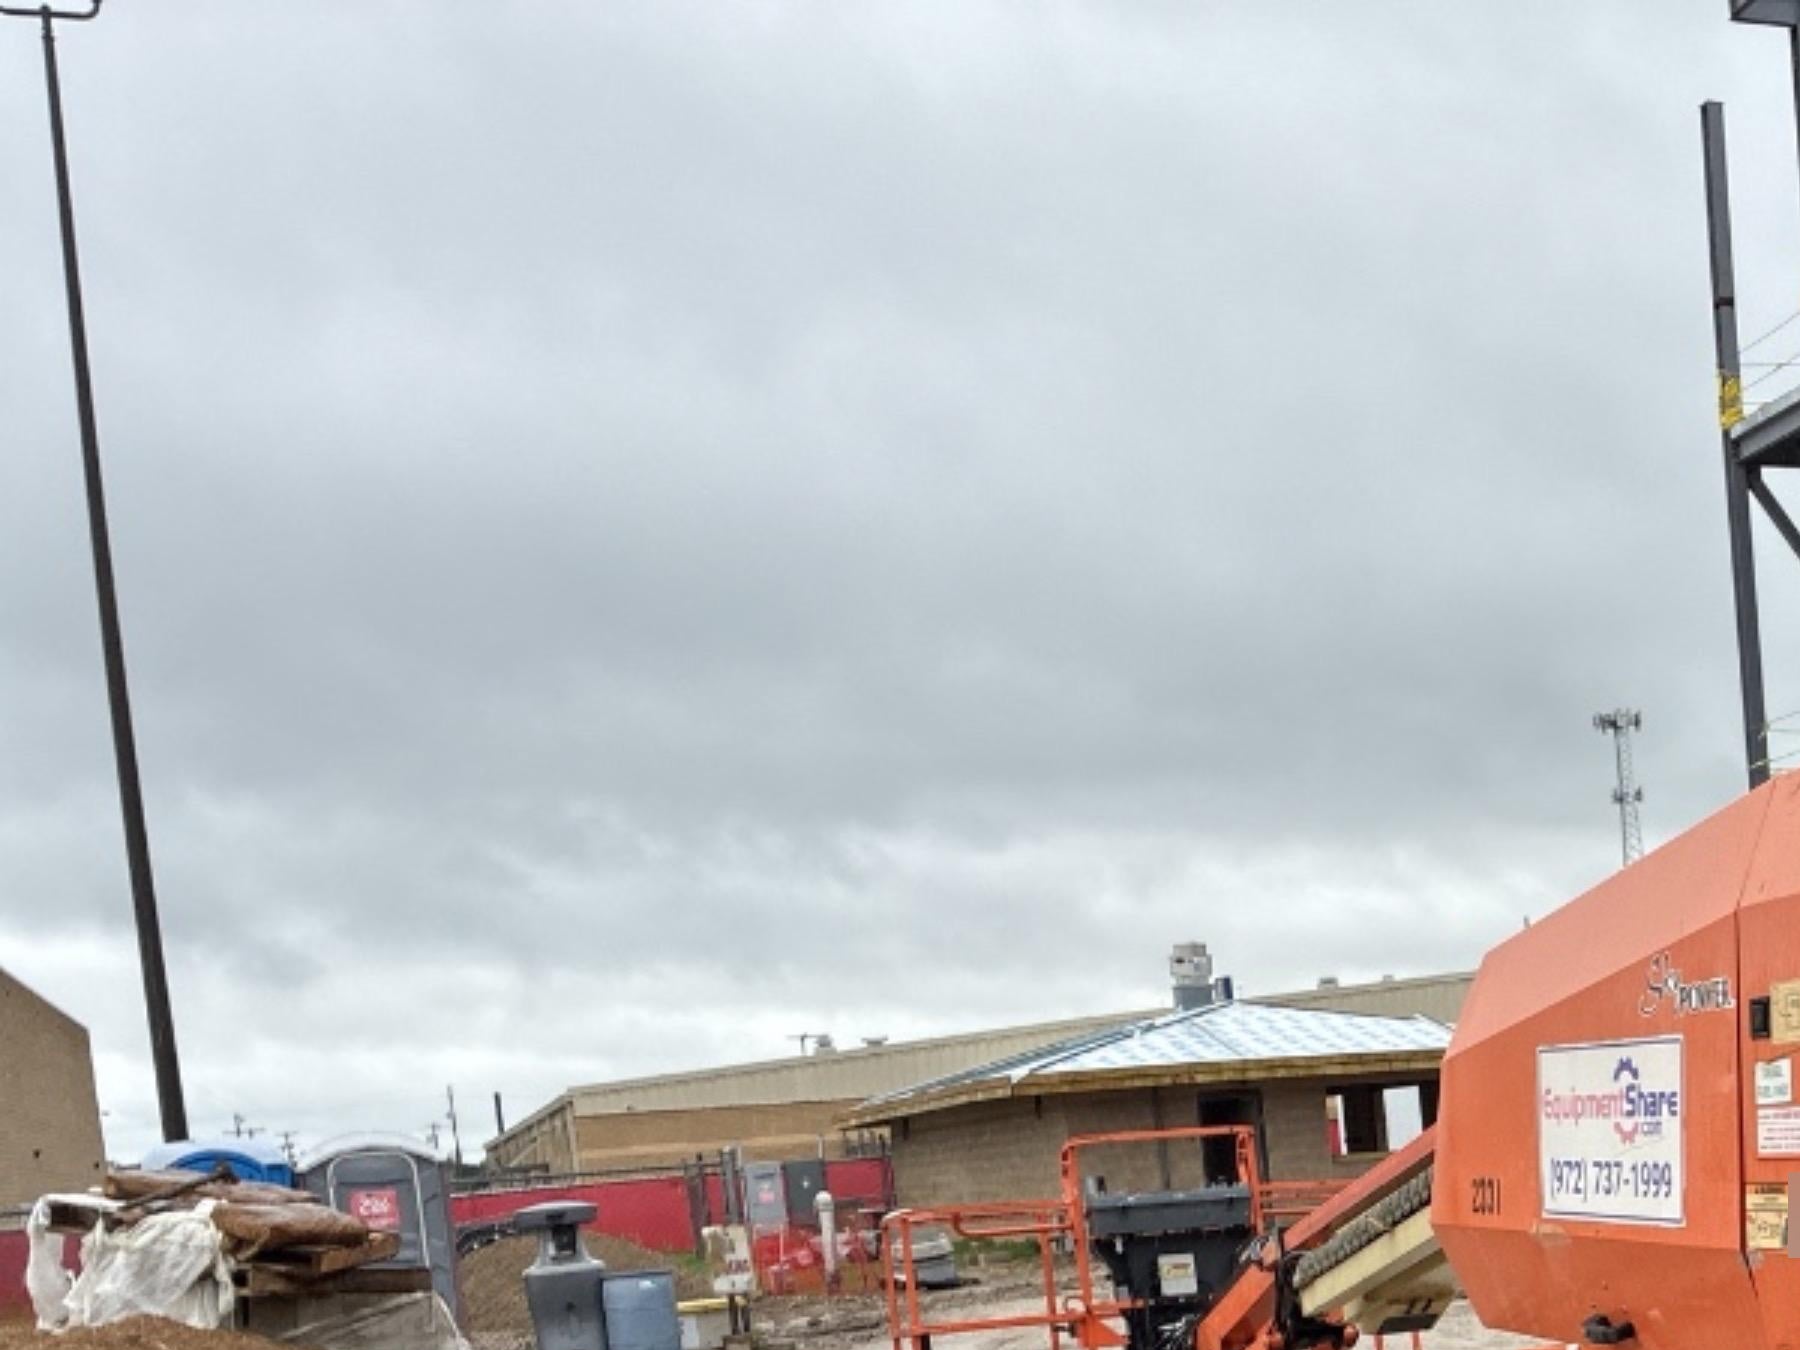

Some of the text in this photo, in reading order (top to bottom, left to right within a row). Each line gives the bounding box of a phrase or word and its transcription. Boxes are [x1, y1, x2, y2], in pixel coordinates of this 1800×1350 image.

[1544, 1084, 1678, 1127] EquipmentShare
[1552, 1158, 1672, 1202] (972) 737-1999
